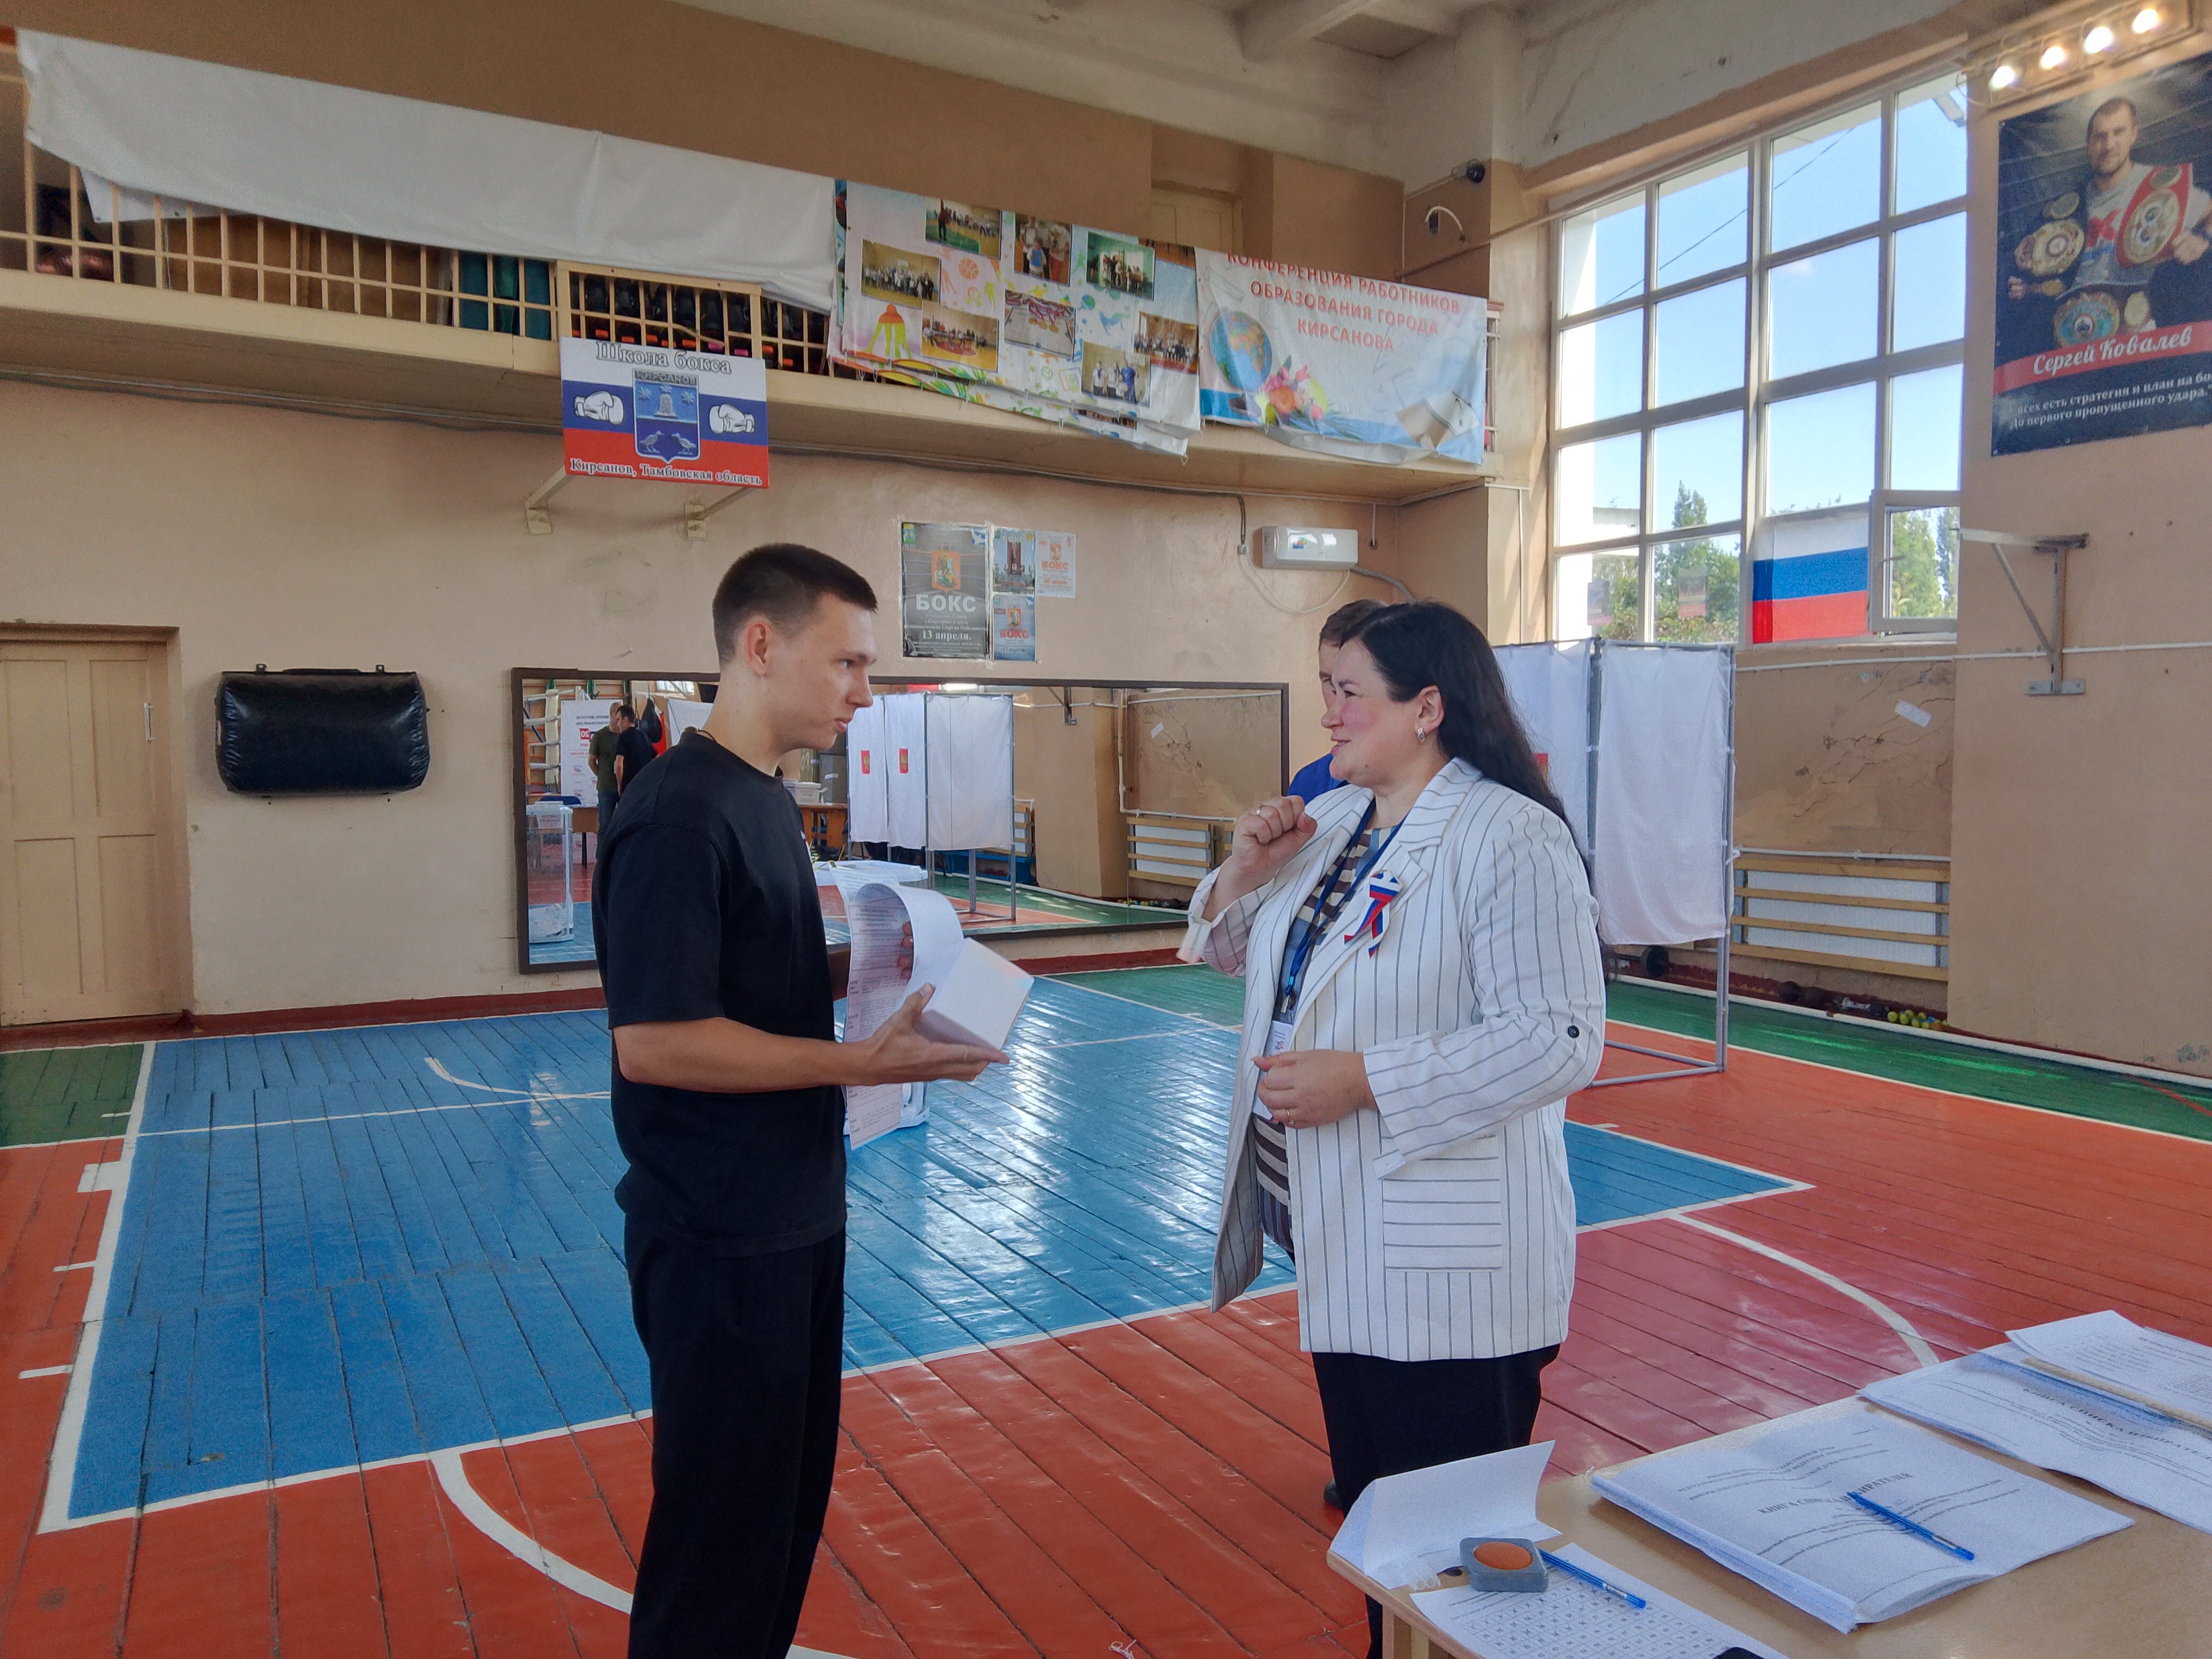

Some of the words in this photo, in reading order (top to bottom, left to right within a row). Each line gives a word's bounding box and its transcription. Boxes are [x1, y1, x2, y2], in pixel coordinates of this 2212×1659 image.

[1227, 253, 1352, 290] КОНФЕРЕНЦИЯ
[1359, 277, 1459, 313] РАБОТНИКОВ
[1251, 281, 1371, 321] ОБРАЗОВАНИЯ
[1378, 308, 1438, 336] ГОРОДА
[1297, 317, 1393, 351] КИРСАНОВА
[2033, 343, 2096, 375] Сергей
[2100, 325, 2193, 360] Ковалев
[596, 341, 669, 367] Школа
[674, 349, 732, 374] бокса
[2043, 399, 2067, 409] есть
[2143, 379, 2174, 392] план
[2177, 375, 2193, 387] на
[2196, 371, 2212, 383] бо
[2075, 395, 2165, 419] пропущенного
[571, 458, 637, 477] Кирсанов,
[640, 464, 713, 481] Тамбовская
[715, 470, 762, 485] область
[916, 594, 977, 613] БОКС
[923, 630, 932, 639] 13
[935, 632, 971, 642] апреля.
[1000, 629, 1029, 639] БОКС
[1757, 1502, 1799, 1514] КНИГА
[1840, 1472, 1914, 1502] ИБИРАТЕЛЕЙ
